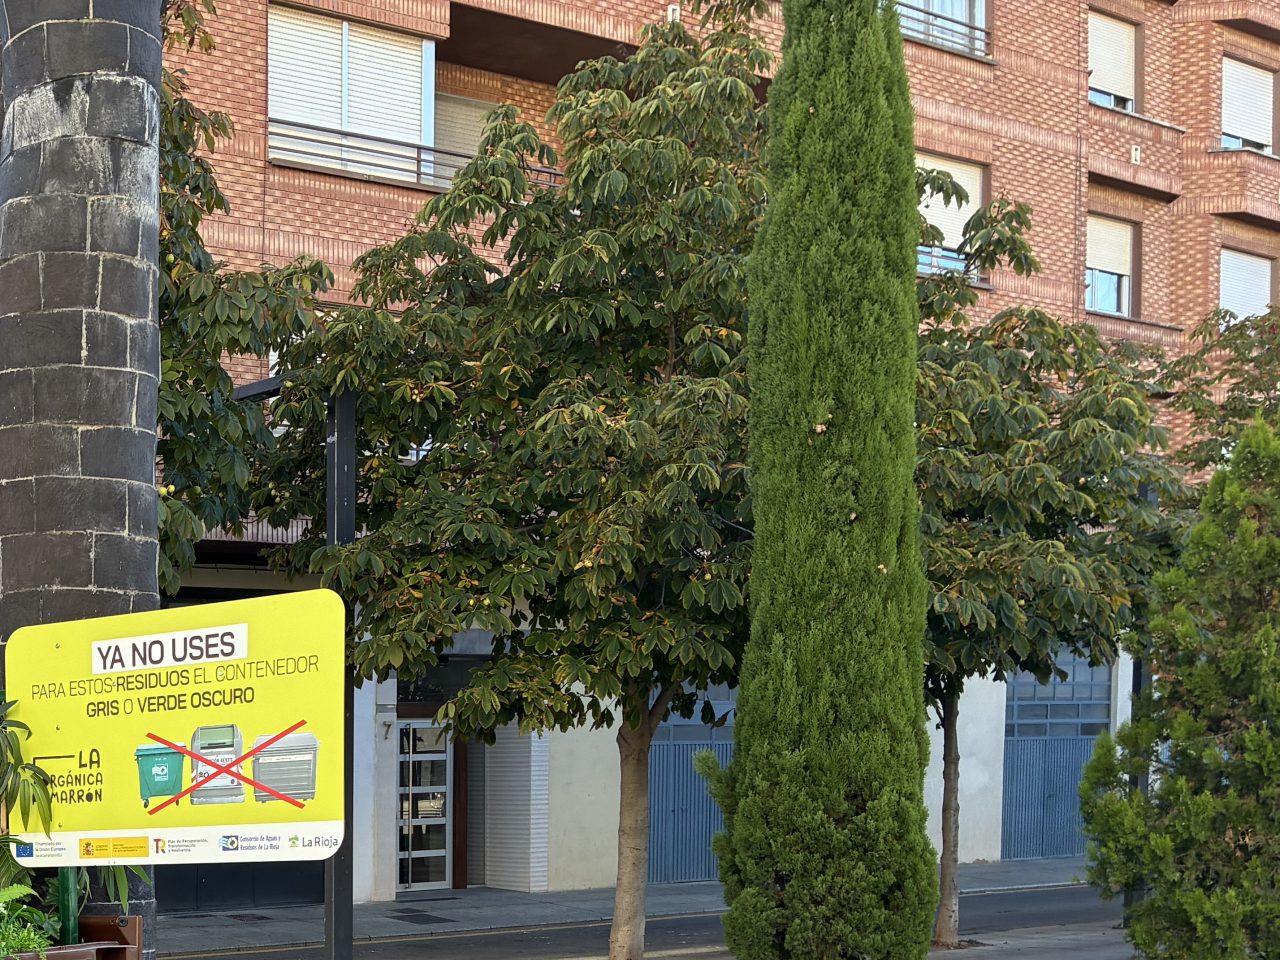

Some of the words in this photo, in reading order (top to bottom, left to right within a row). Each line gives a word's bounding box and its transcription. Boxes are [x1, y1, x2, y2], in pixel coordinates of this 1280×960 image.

[97, 644, 126, 670] YA
[131, 640, 164, 667] NO
[171, 631, 236, 662] USES
[32, 682, 66, 700] PARA
[70, 678, 112, 696] ESTOS
[116, 670, 190, 692] RESIDUOS
[194, 668, 212, 684] EL
[216, 654, 319, 682] CONTENEDOR
[86, 700, 120, 718] GRIS
[124, 698, 134, 714] O
[137, 694, 187, 713] VERDE
[190, 686, 255, 709] OSCURO
[383, 721, 392, 740] 7
[79, 748, 100, 769] LA
[43, 770, 103, 788] RGÁNICA
[302, 837, 313, 847] La
[314, 836, 339, 848] Rioja
